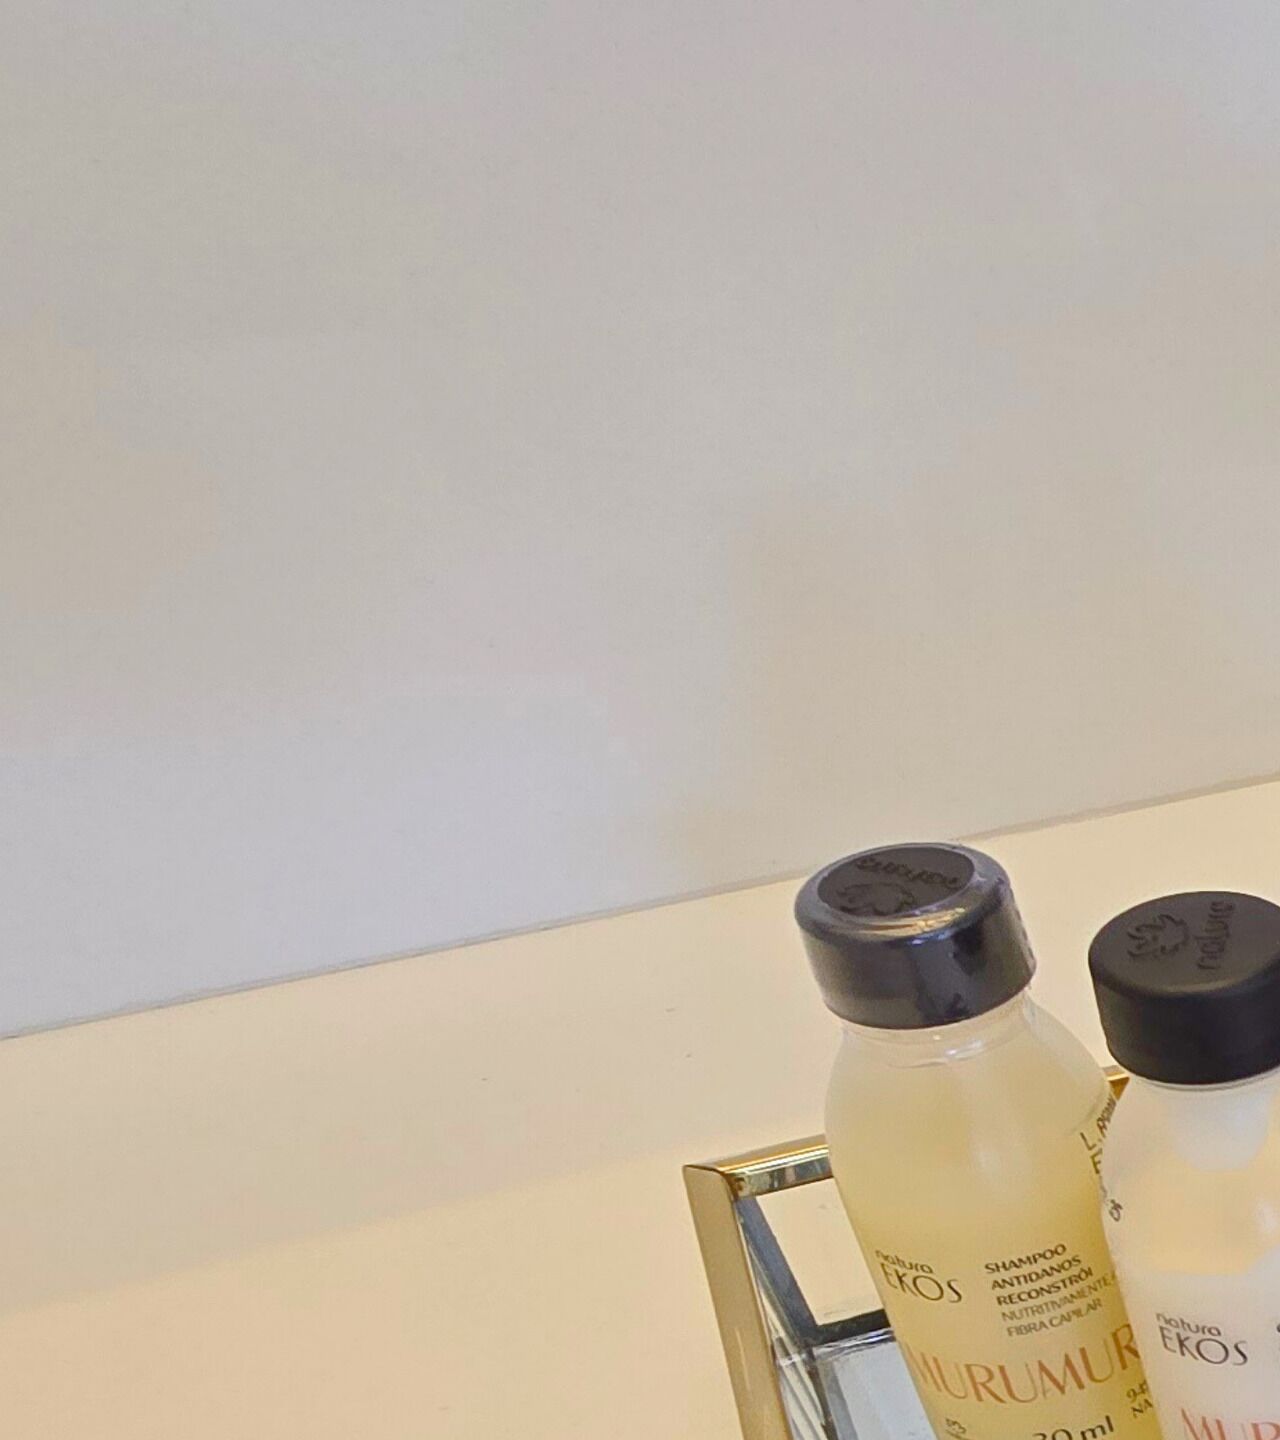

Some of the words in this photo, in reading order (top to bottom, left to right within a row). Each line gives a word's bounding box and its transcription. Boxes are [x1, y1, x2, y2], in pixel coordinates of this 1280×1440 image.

[984, 1243, 1067, 1274] SHAMPOO
[991, 1255, 1083, 1290] ANTIDANOS
[880, 1263, 963, 1304] EKOS
[996, 1267, 1094, 1306] RECONSTRÓI
[1006, 1319, 1048, 1337] FIBRA
[1048, 1297, 1102, 1328] CAPILAR
[1156, 1312, 1222, 1338] natura
[906, 1323, 1141, 1404] MURUMUR
[1159, 1325, 1249, 1366] EKOS
